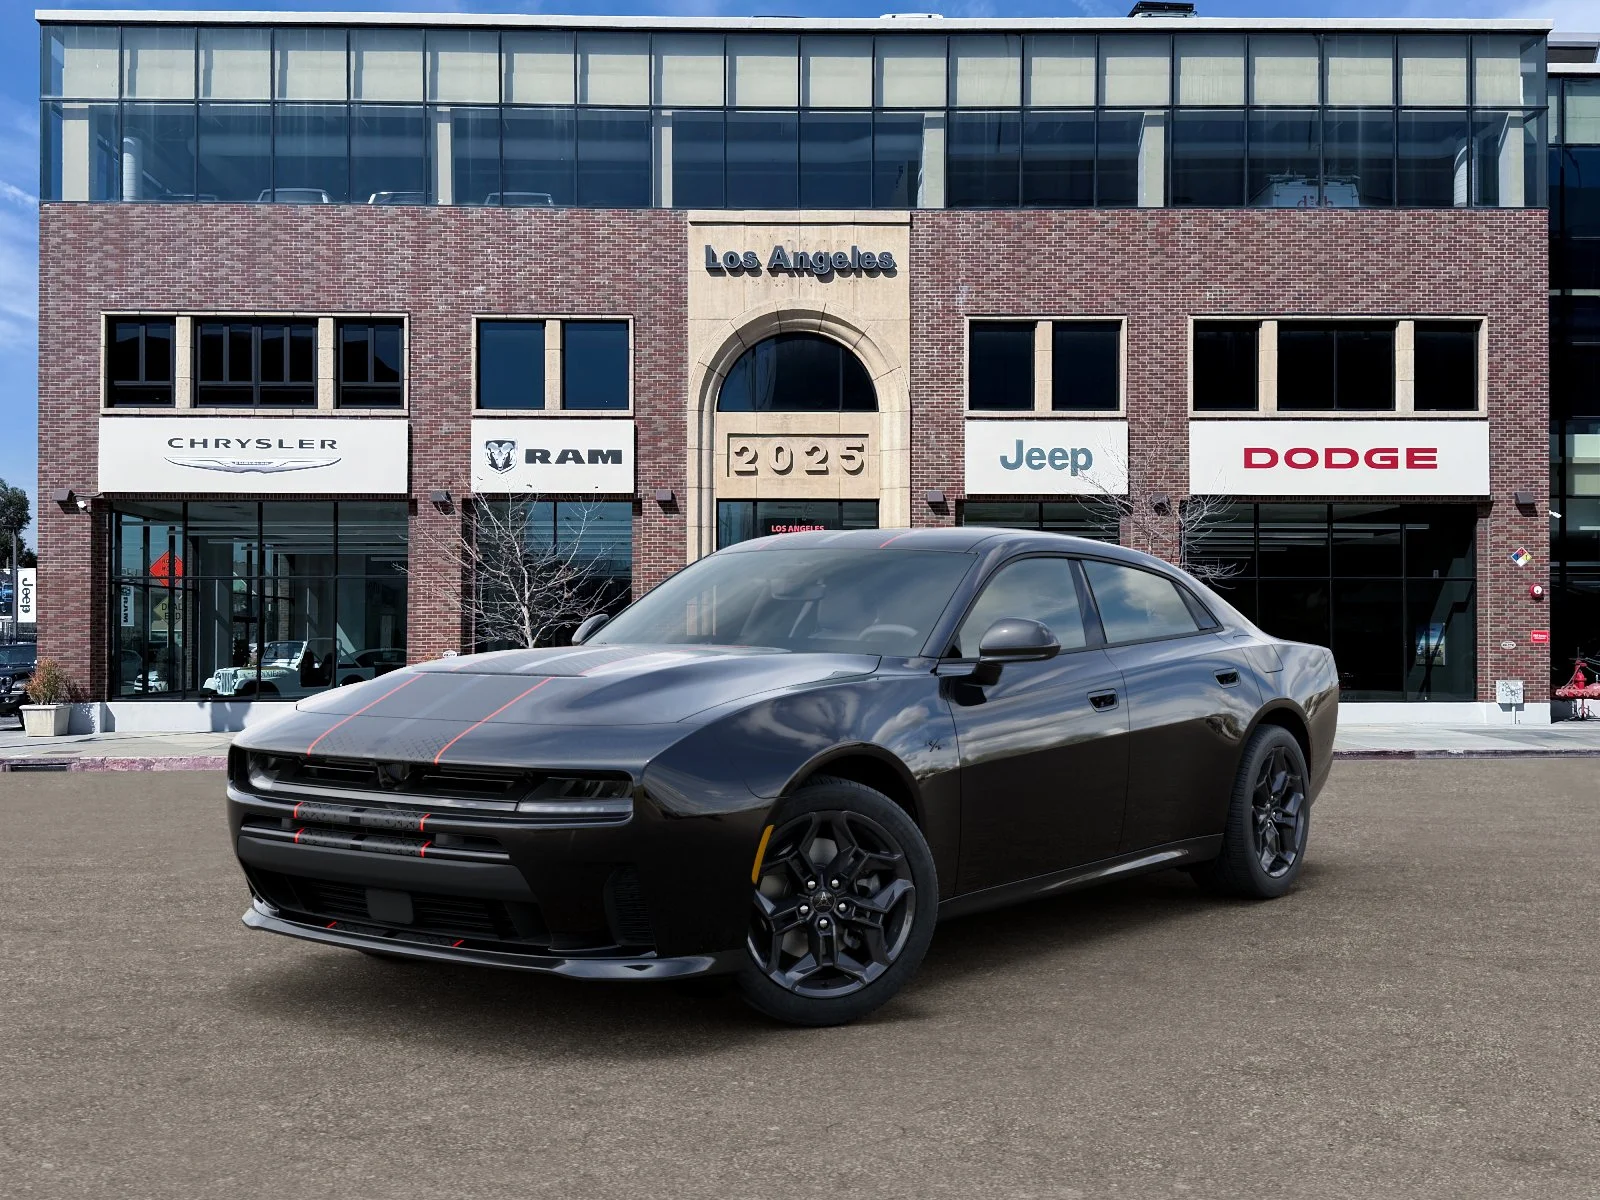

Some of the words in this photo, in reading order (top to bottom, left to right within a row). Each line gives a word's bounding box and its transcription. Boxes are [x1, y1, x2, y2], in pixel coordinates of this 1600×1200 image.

[705, 244, 759, 270] Los
[767, 244, 894, 275] Angeles
[167, 438, 338, 450] CHRYSLER
[525, 448, 623, 465] RAM
[734, 441, 866, 475] 2025
[1000, 439, 1093, 476] Jeep
[1244, 447, 1438, 470] DODGE
[20, 577, 34, 614] Jeep
